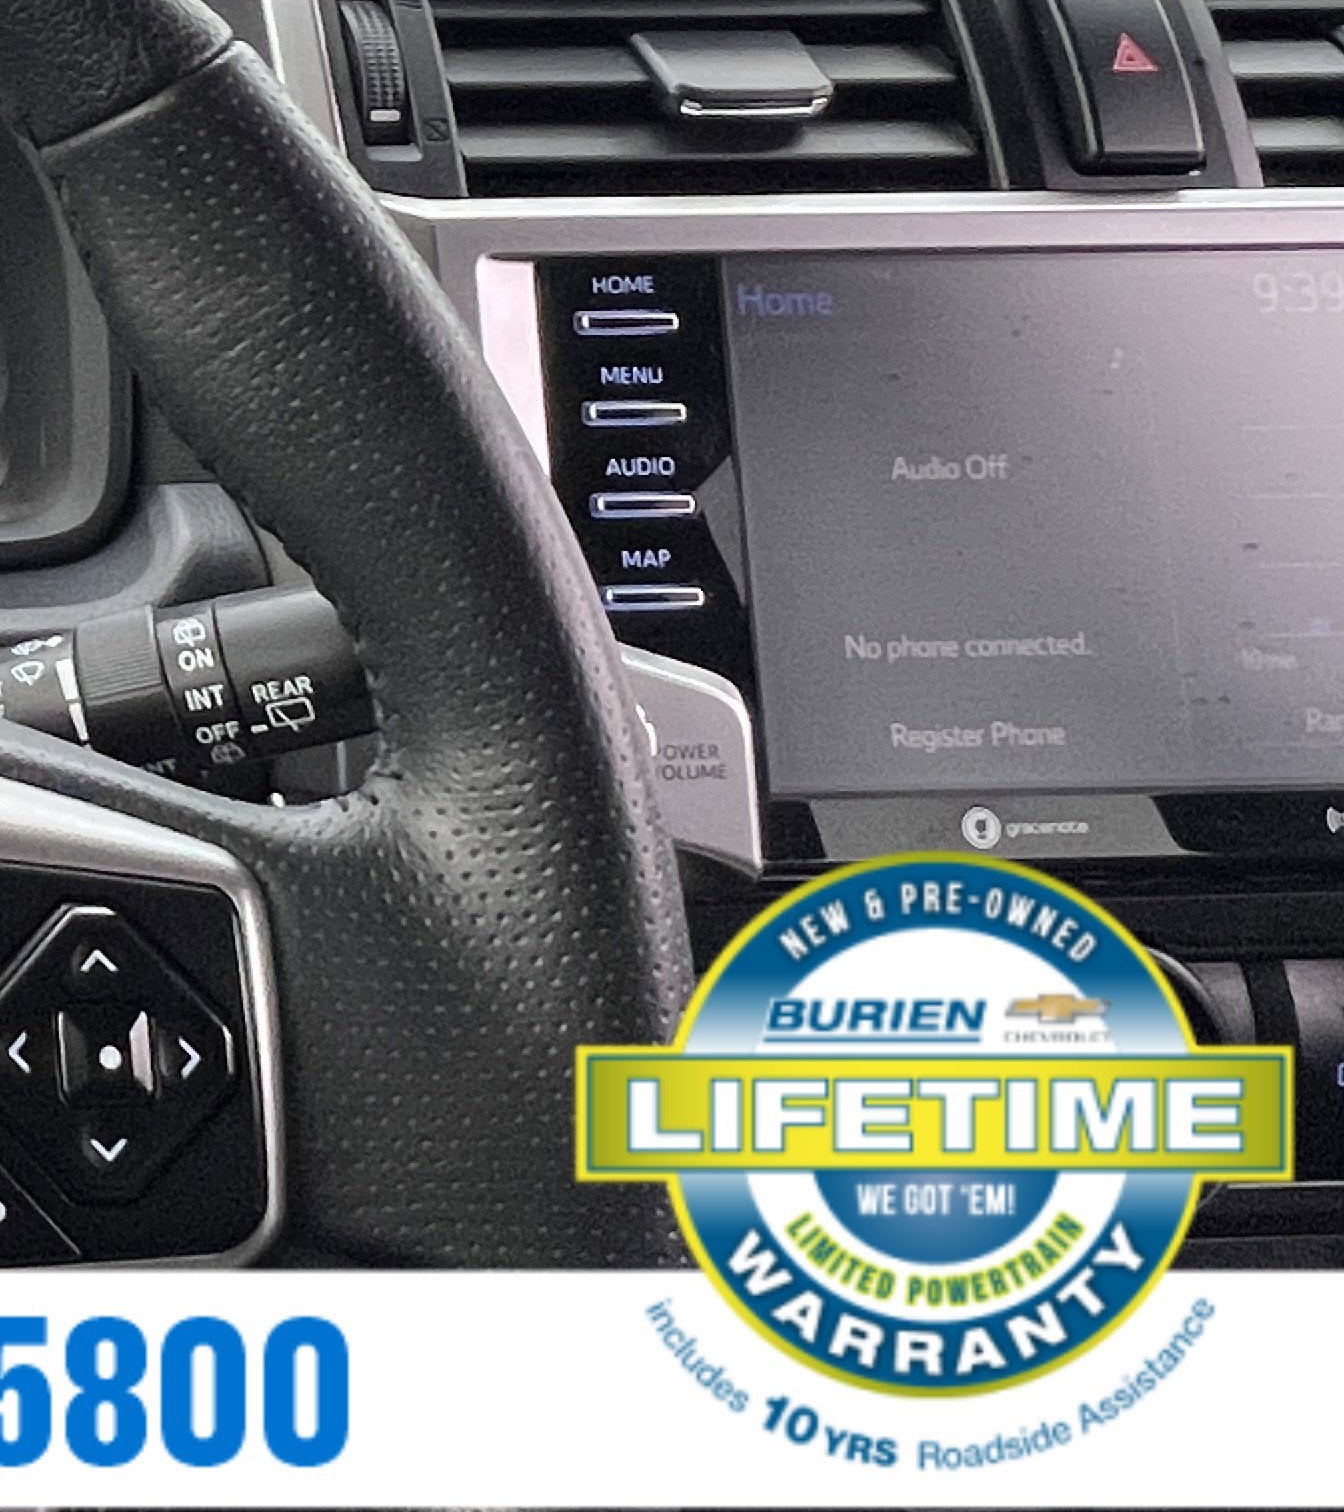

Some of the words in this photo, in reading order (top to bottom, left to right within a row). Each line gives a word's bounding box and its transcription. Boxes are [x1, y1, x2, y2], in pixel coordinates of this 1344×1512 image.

[591, 275, 654, 294] HOME
[737, 285, 834, 319] Home
[600, 366, 664, 385] MENU
[605, 457, 676, 477] AUDIO
[890, 455, 959, 482] Audio
[965, 452, 1010, 481] Off
[621, 549, 671, 569] MAP
[178, 648, 215, 672] ON
[844, 635, 881, 659] No
[888, 633, 960, 664] phone
[965, 632, 1093, 659] connected.
[184, 683, 226, 712] INT
[251, 675, 314, 703] REAR
[195, 720, 240, 744] OFF
[890, 722, 983, 751] Register
[991, 722, 1066, 749] Phone
